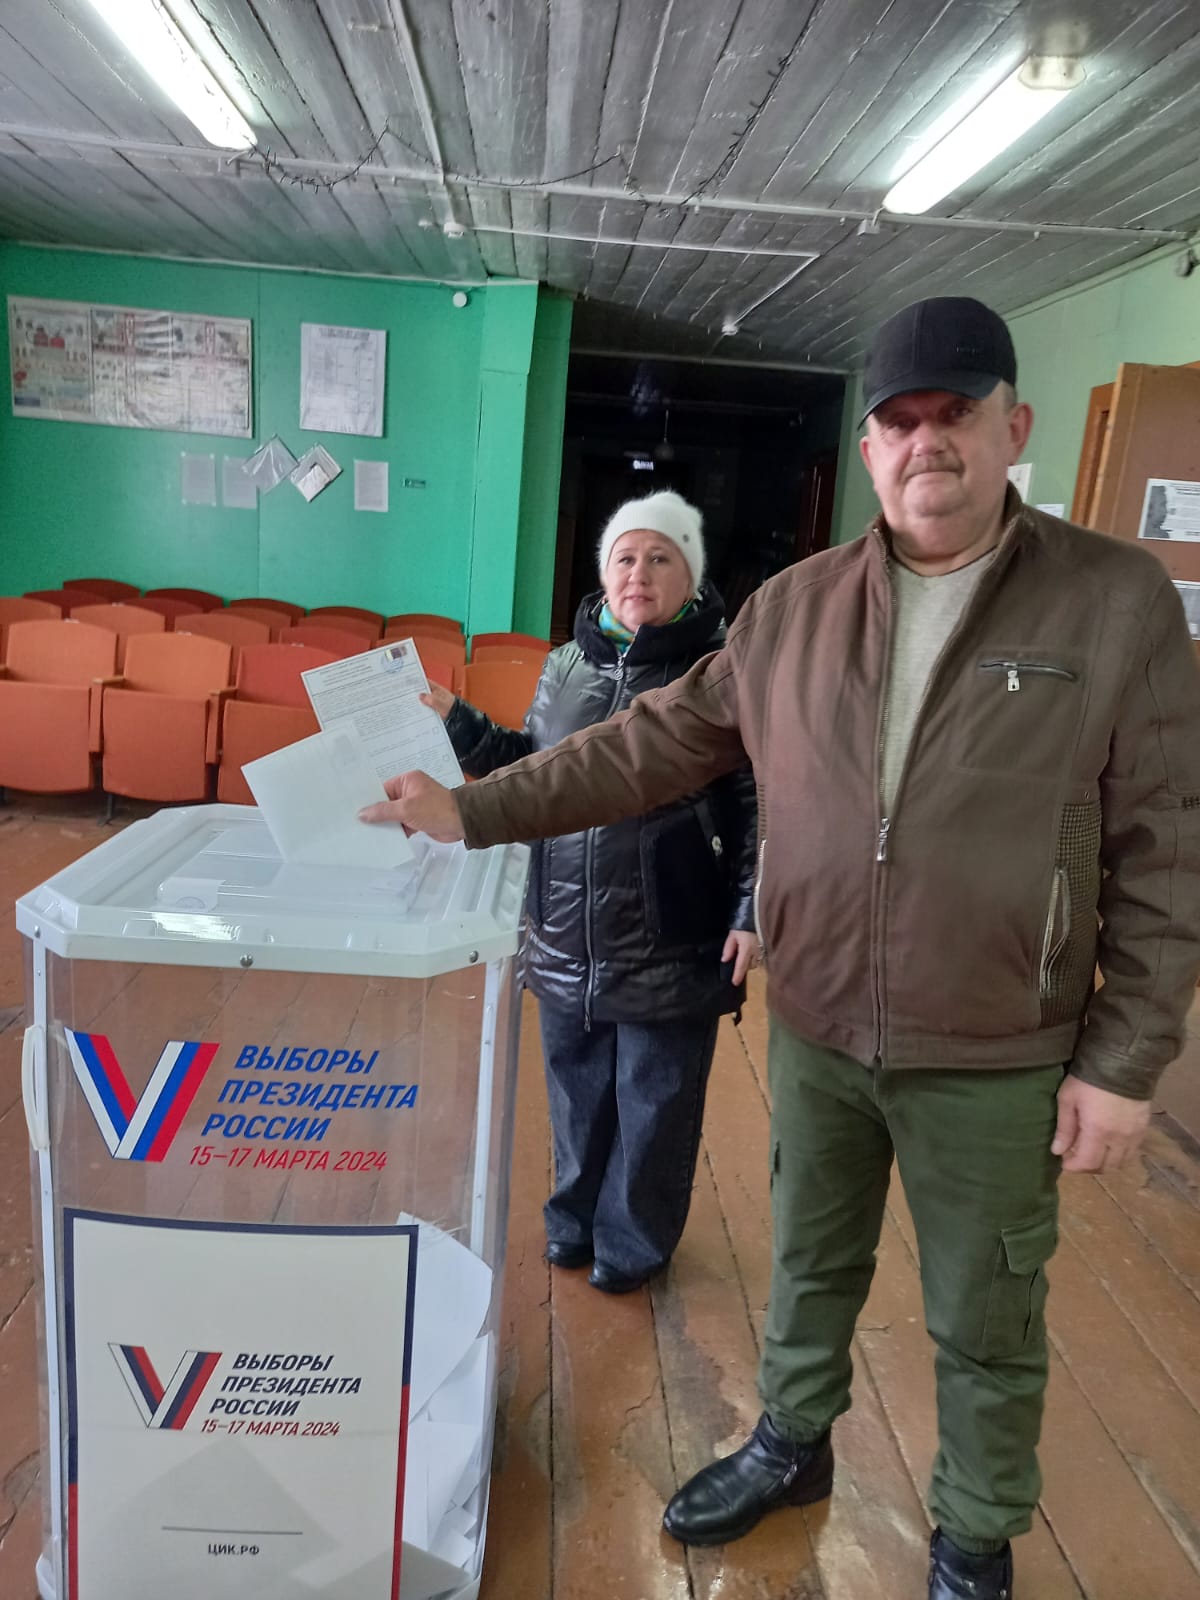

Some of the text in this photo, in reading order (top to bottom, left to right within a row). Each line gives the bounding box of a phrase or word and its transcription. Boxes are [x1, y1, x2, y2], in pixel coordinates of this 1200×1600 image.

[234, 1044, 380, 1075] ВЫБОРЫ
[217, 1079, 420, 1111] ПРЕЗИДЕНТА
[200, 1113, 332, 1142] РОССИИ
[253, 1150, 330, 1171] МАРТА
[332, 1151, 389, 1172] 2024
[231, 1353, 335, 1372] ВЫБОРЫ
[220, 1375, 362, 1397] ПРЕЗИДЕНТА
[208, 1398, 301, 1417] РОССИИ
[246, 1421, 300, 1437] МАРТА
[301, 1422, 341, 1437] 2024
[208, 1544, 260, 1557] ЦИК.РФ
